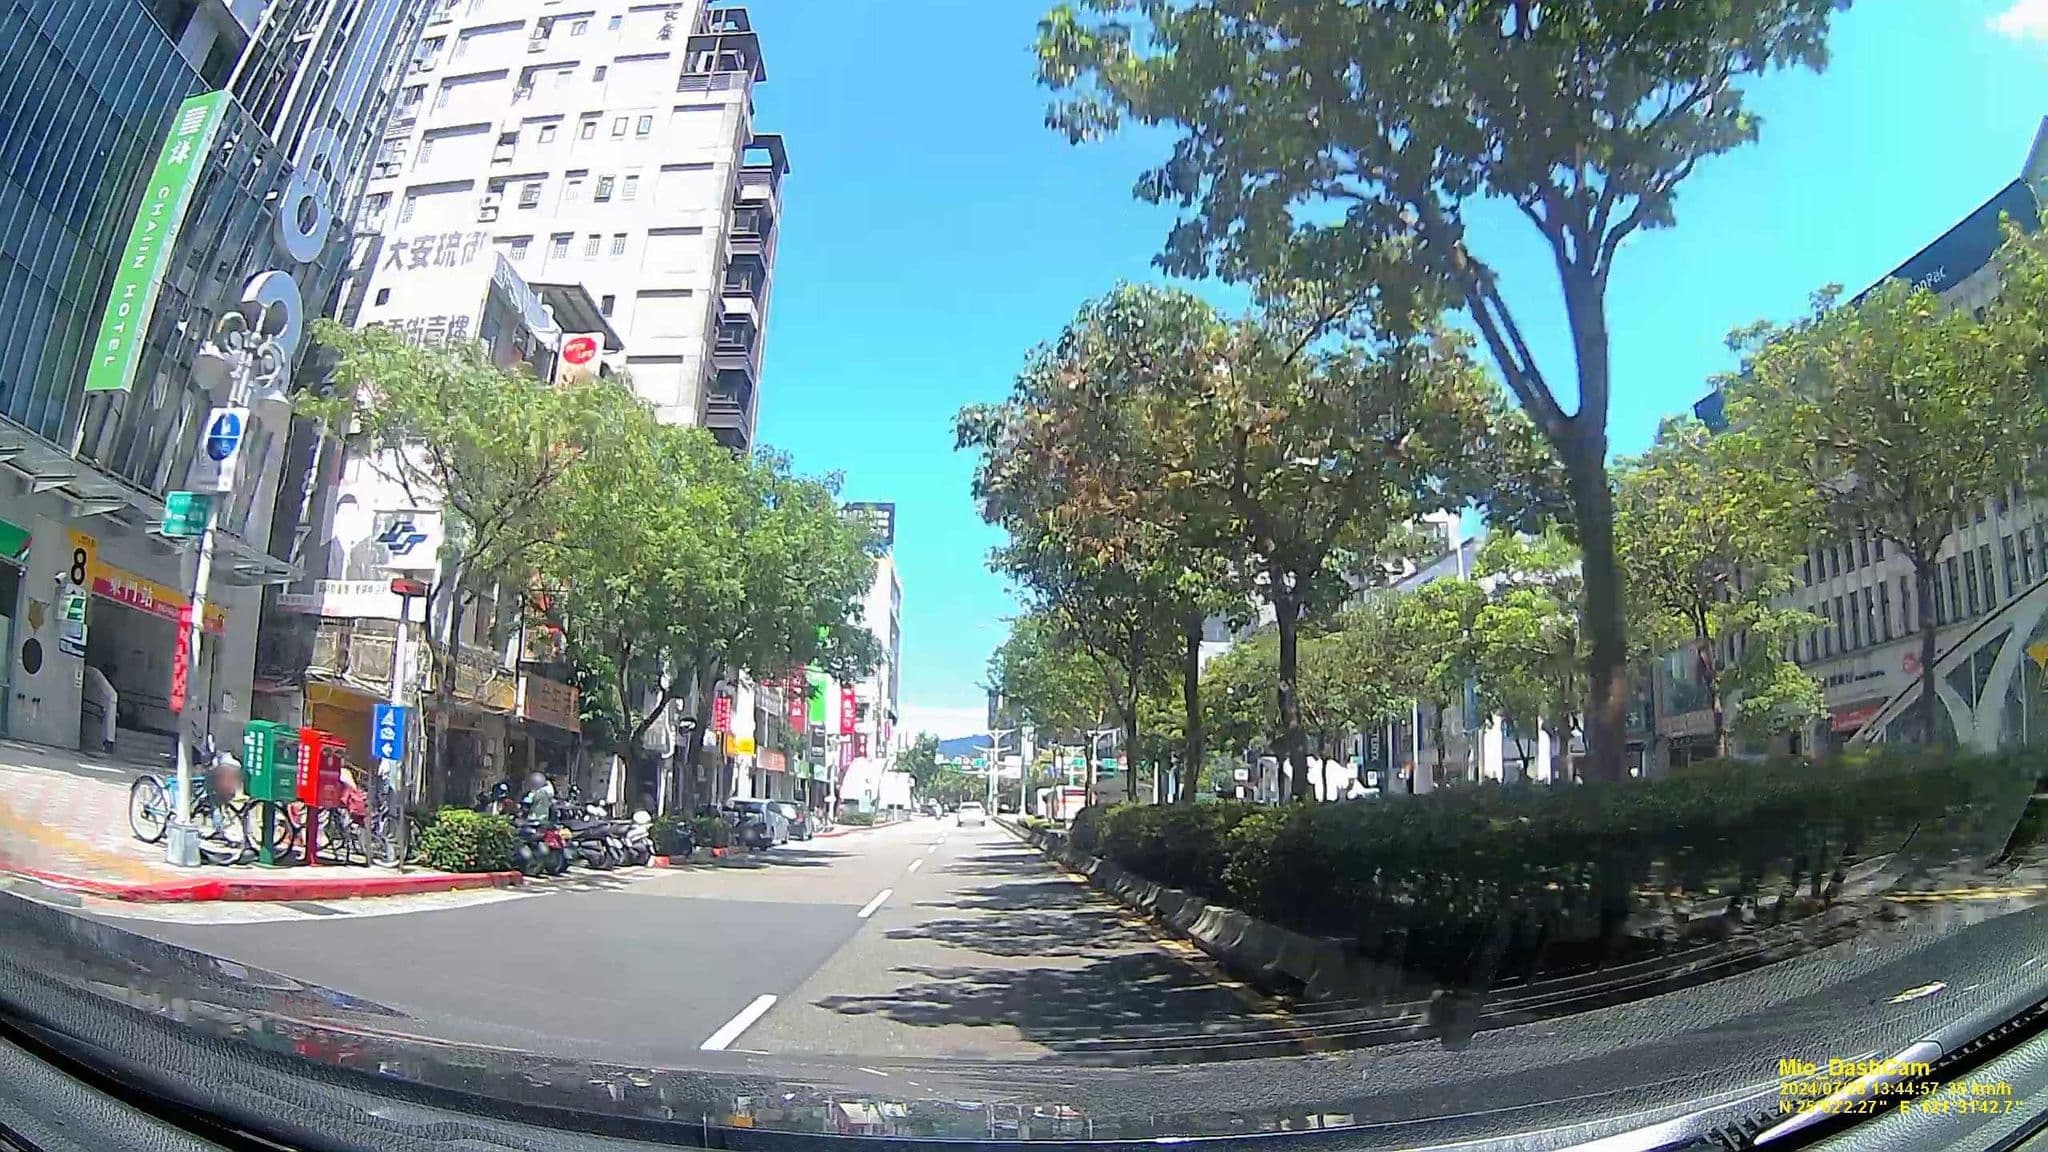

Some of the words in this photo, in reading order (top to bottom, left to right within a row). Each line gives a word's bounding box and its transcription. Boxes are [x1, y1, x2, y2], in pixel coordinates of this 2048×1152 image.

[103, 283, 137, 367] HOTEL
[71, 547, 87, 586] 8
[110, 575, 154, 608] 東門站
